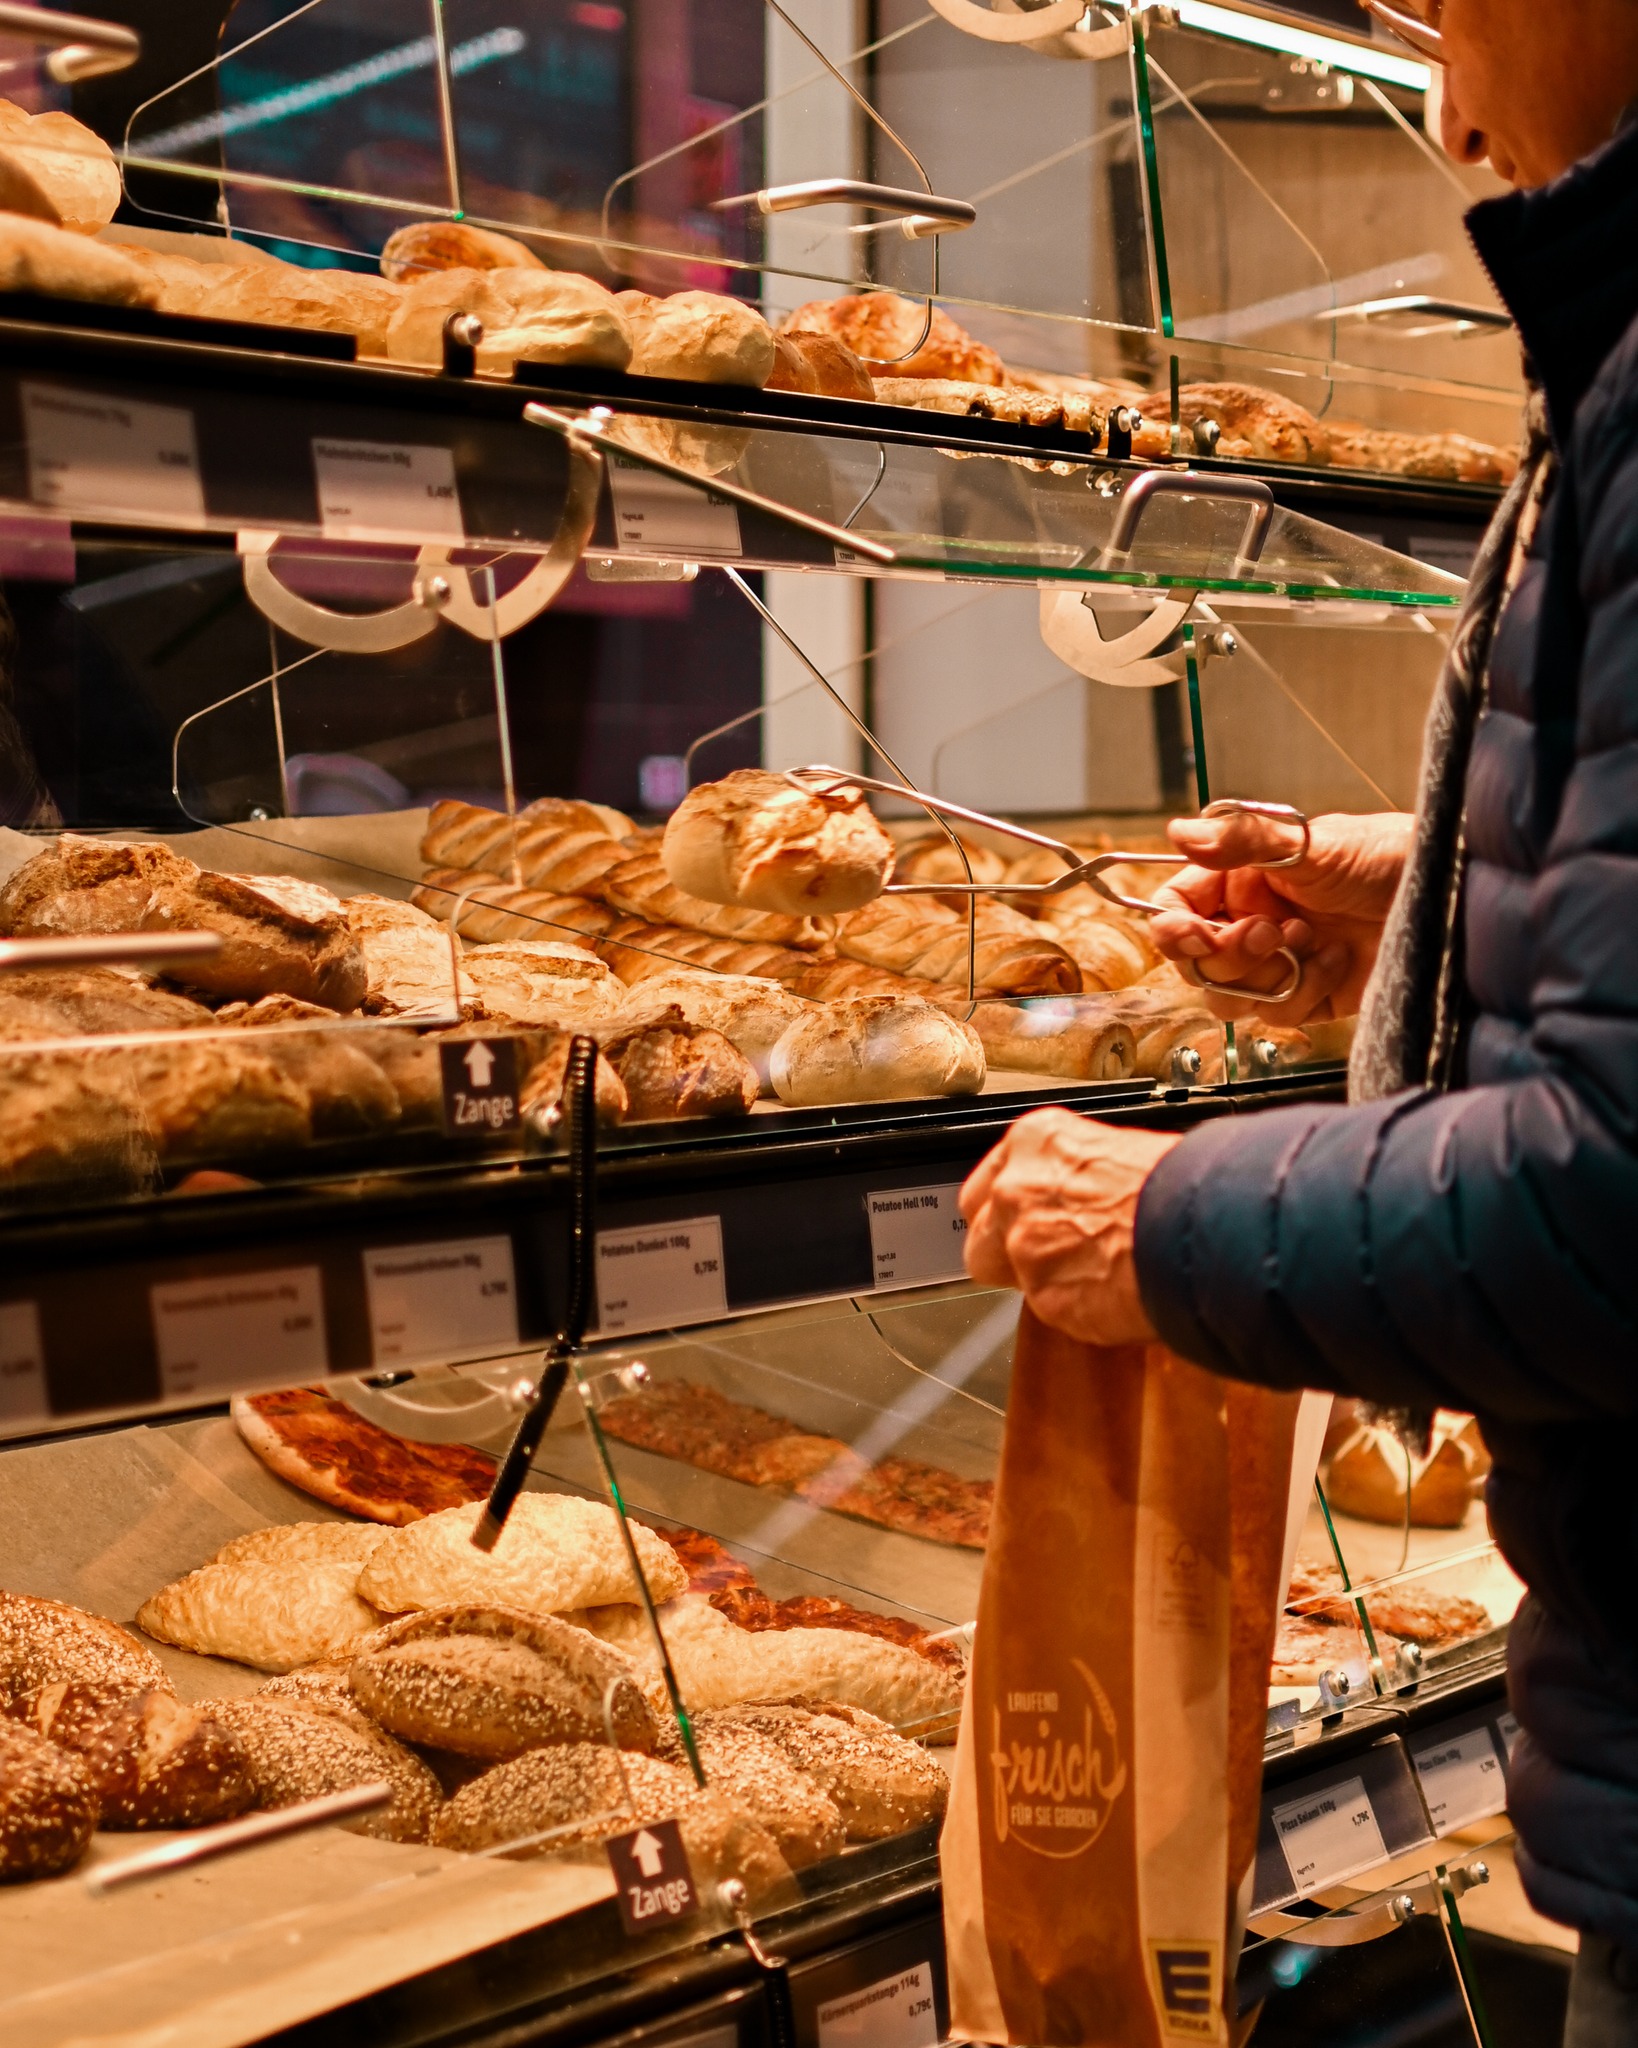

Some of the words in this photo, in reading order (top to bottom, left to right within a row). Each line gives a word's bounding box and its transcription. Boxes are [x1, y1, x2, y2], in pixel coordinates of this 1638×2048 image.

[455, 1092, 513, 1128] Zange
[872, 1201, 902, 1213] Potatoe
[903, 1196, 920, 1210] Hell
[920, 1195, 939, 1209] 100g
[1007, 1691, 1059, 1713] LAUFEND
[990, 1703, 1128, 1843] frisch
[1010, 1802, 1033, 1827] FÜR
[1035, 1805, 1051, 1827] SIE
[1053, 1806, 1098, 1829] GEBACKEN
[1297, 1806, 1320, 1825] Salami
[628, 1879, 690, 1919] Zange
[1156, 1951, 1211, 2014] E
